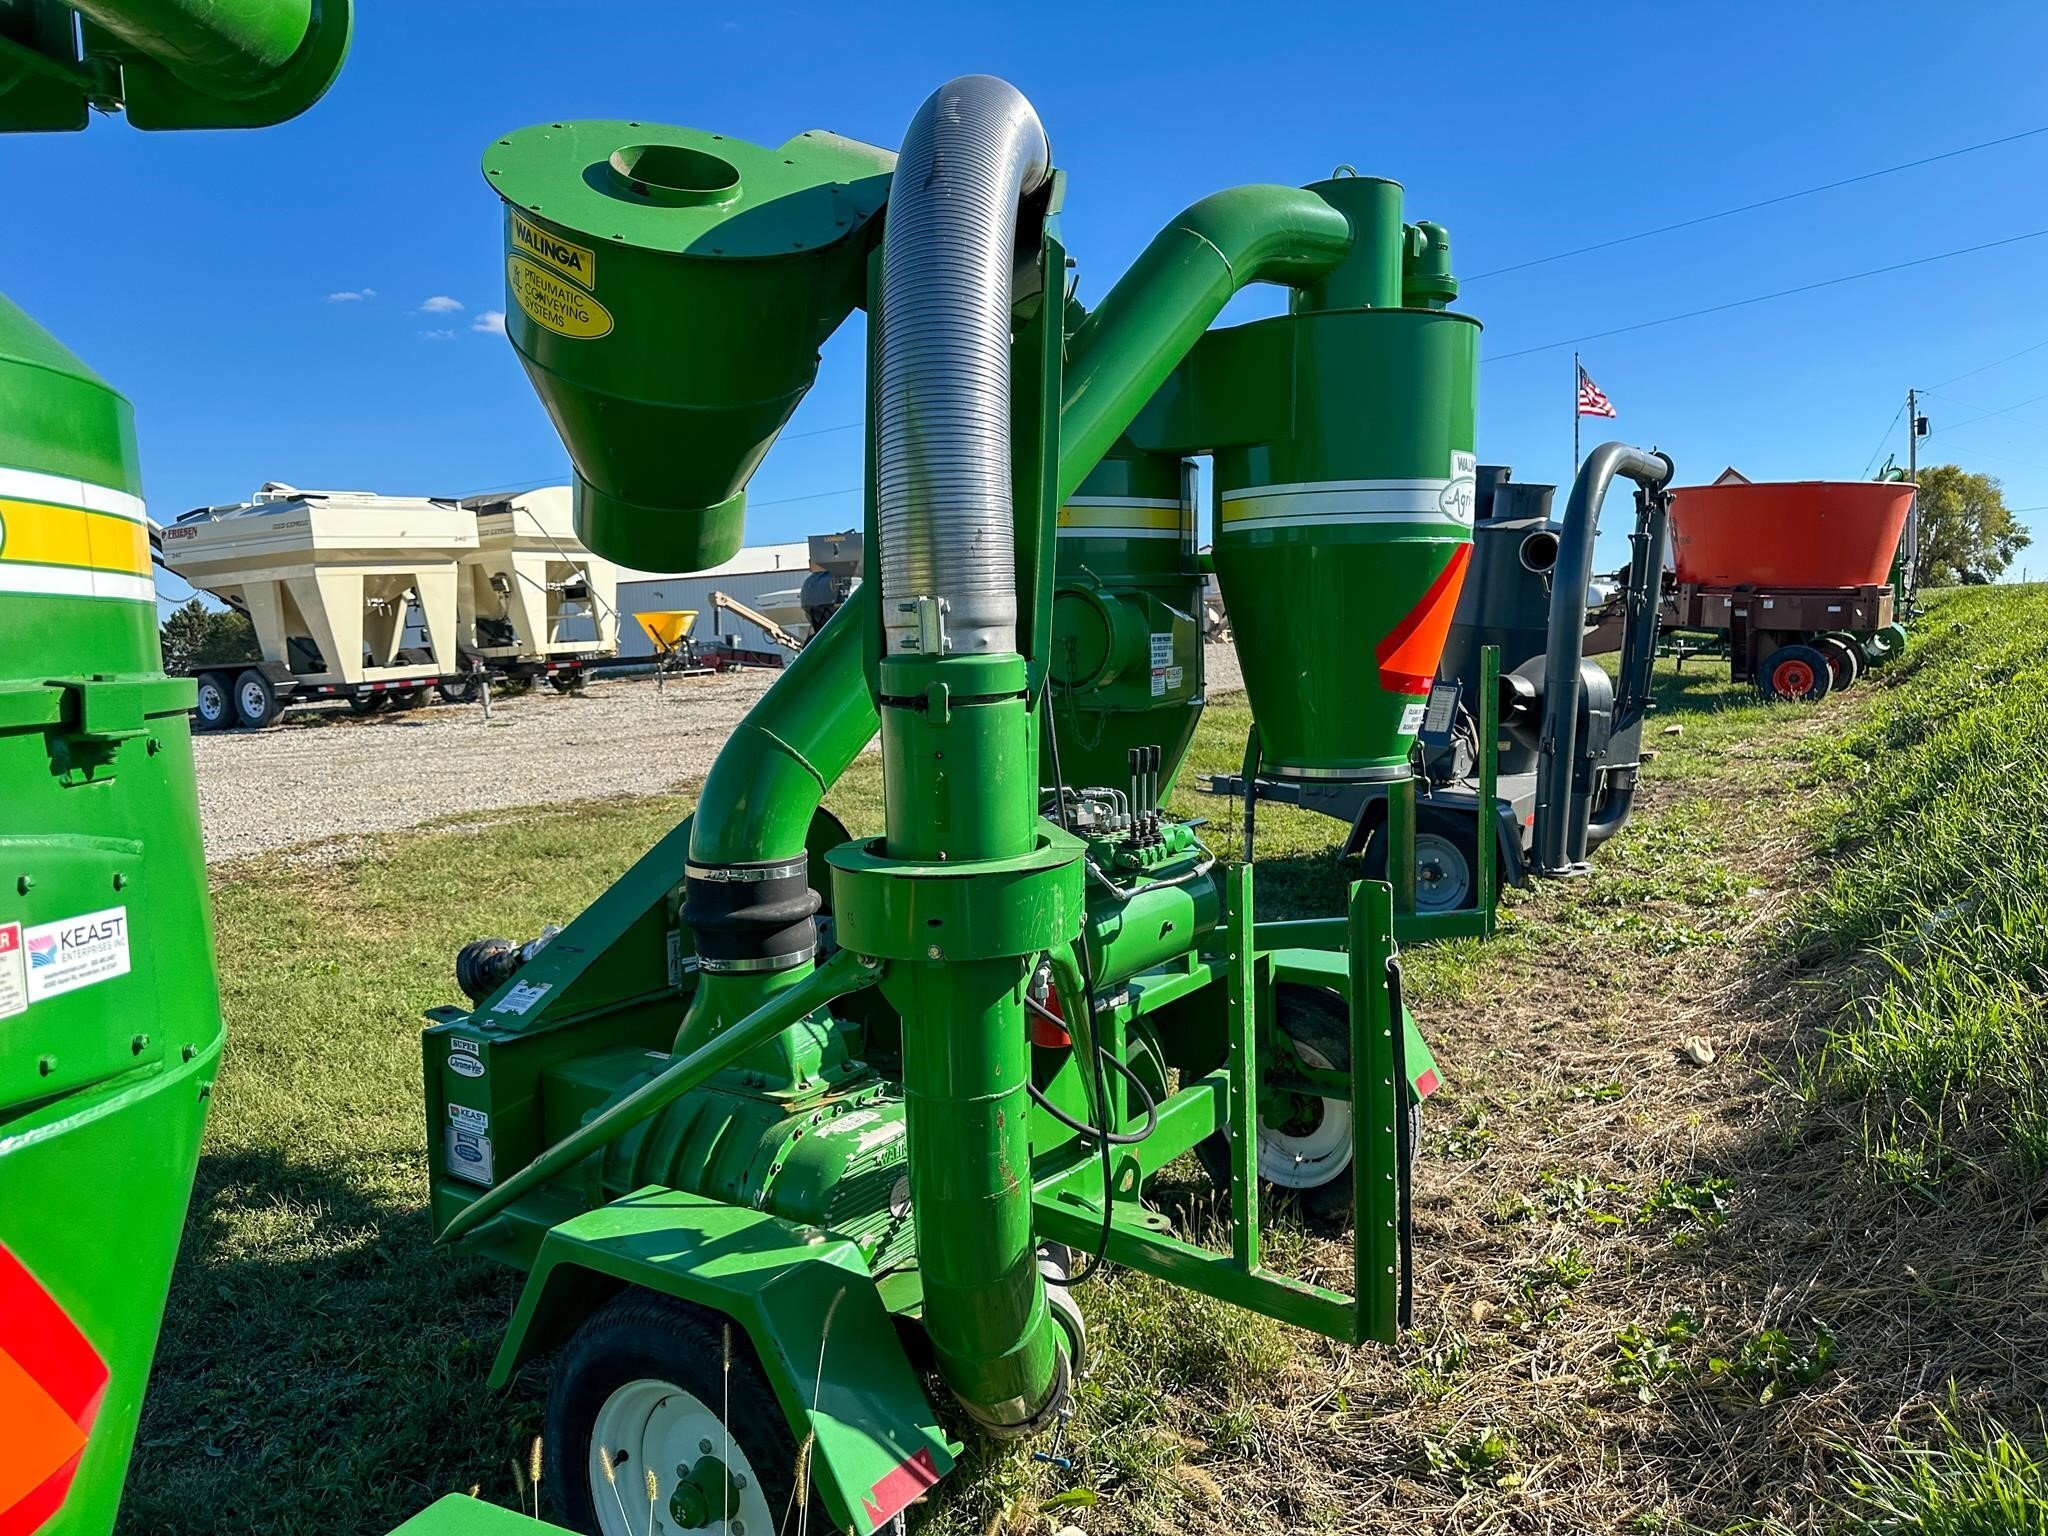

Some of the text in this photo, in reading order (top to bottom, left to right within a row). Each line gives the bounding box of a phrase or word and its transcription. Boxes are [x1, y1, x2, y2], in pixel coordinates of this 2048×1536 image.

[515, 218, 582, 272] WALINGA
[524, 267, 584, 307] PNEUMATIC
[525, 282, 590, 323] CONVEYING
[525, 296, 565, 328] SYSTEMS
[168, 526, 197, 539] FRIESEN
[60, 916, 124, 951] KEAST
[61, 936, 126, 963] ENTERPRISES INC
[452, 1039, 478, 1052] SUPER
[450, 1056, 483, 1075] Chrome-Vac
[460, 1108, 486, 1122] KEAST
